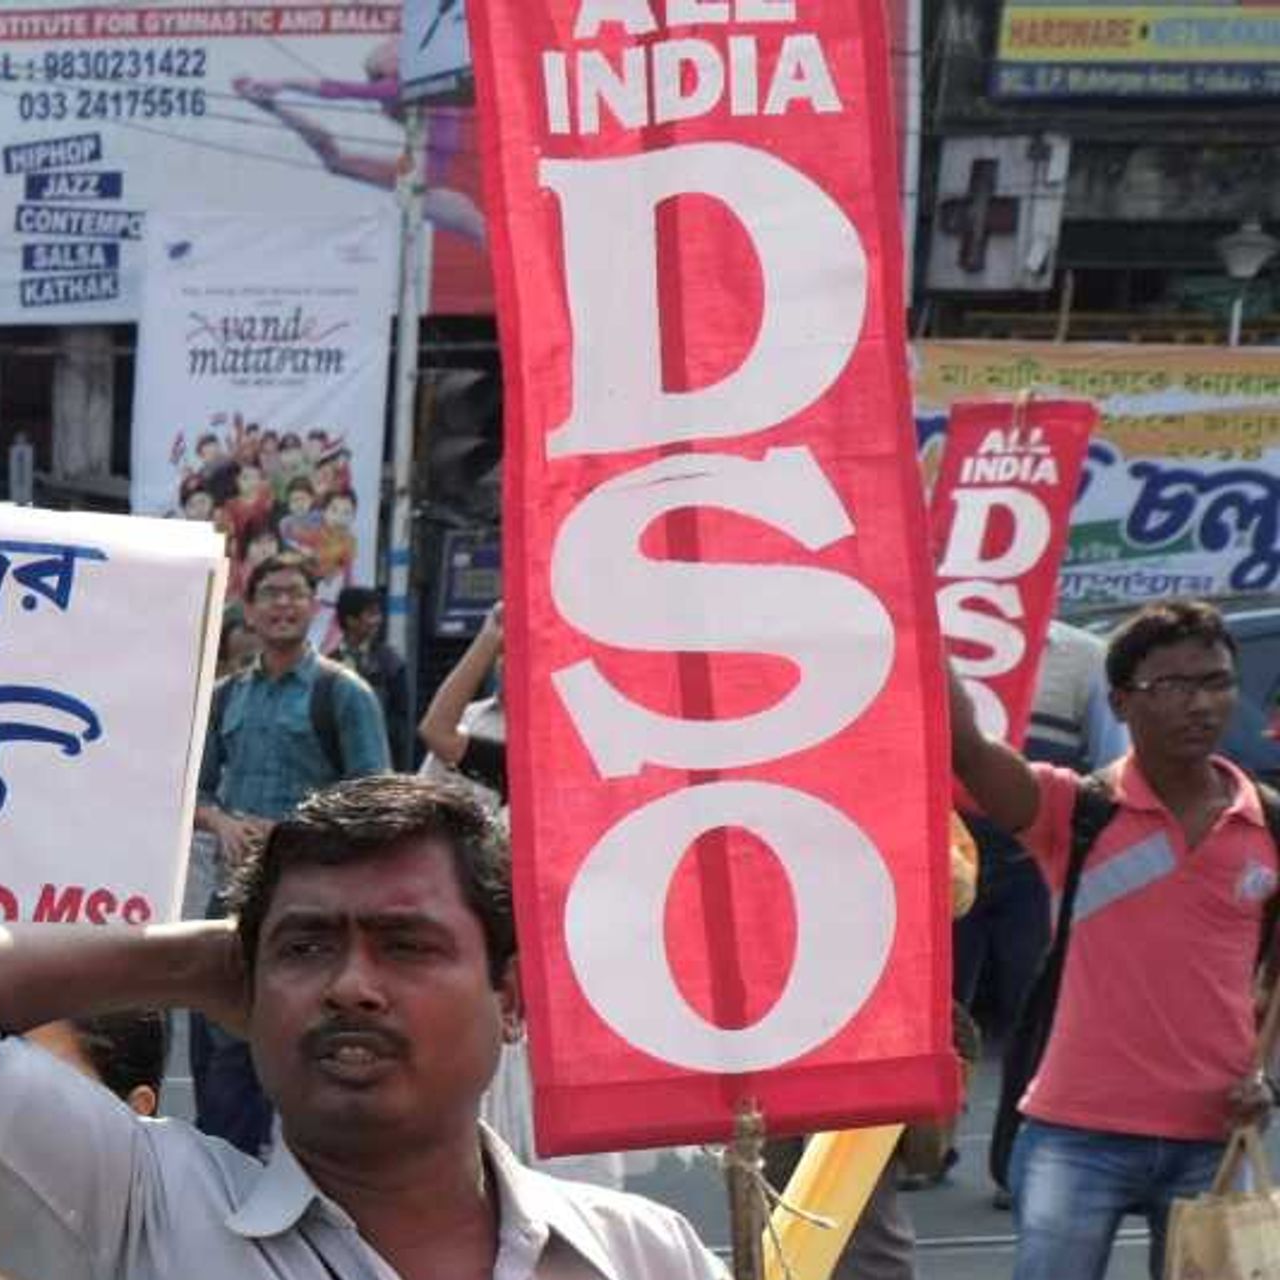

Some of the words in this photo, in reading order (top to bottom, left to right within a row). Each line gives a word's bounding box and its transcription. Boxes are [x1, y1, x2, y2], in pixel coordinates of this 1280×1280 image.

[92, 12, 138, 37] FOR
[142, 10, 274, 36] GYMNASTIC
[281, 10, 323, 34] AND
[43, 49, 207, 81] 9830231422
[543, 33, 844, 135] INDIA
[20, 92, 69, 121] 033
[9, 140, 98, 173] HIPHOP
[43, 175, 101, 197] JAZZ
[31, 244, 107, 269] SALSA
[25, 275, 117, 305] KATHAK
[189, 346, 346, 375] mataram
[977, 427, 1050, 456] ALL
[959, 456, 1059, 486] INDIA
